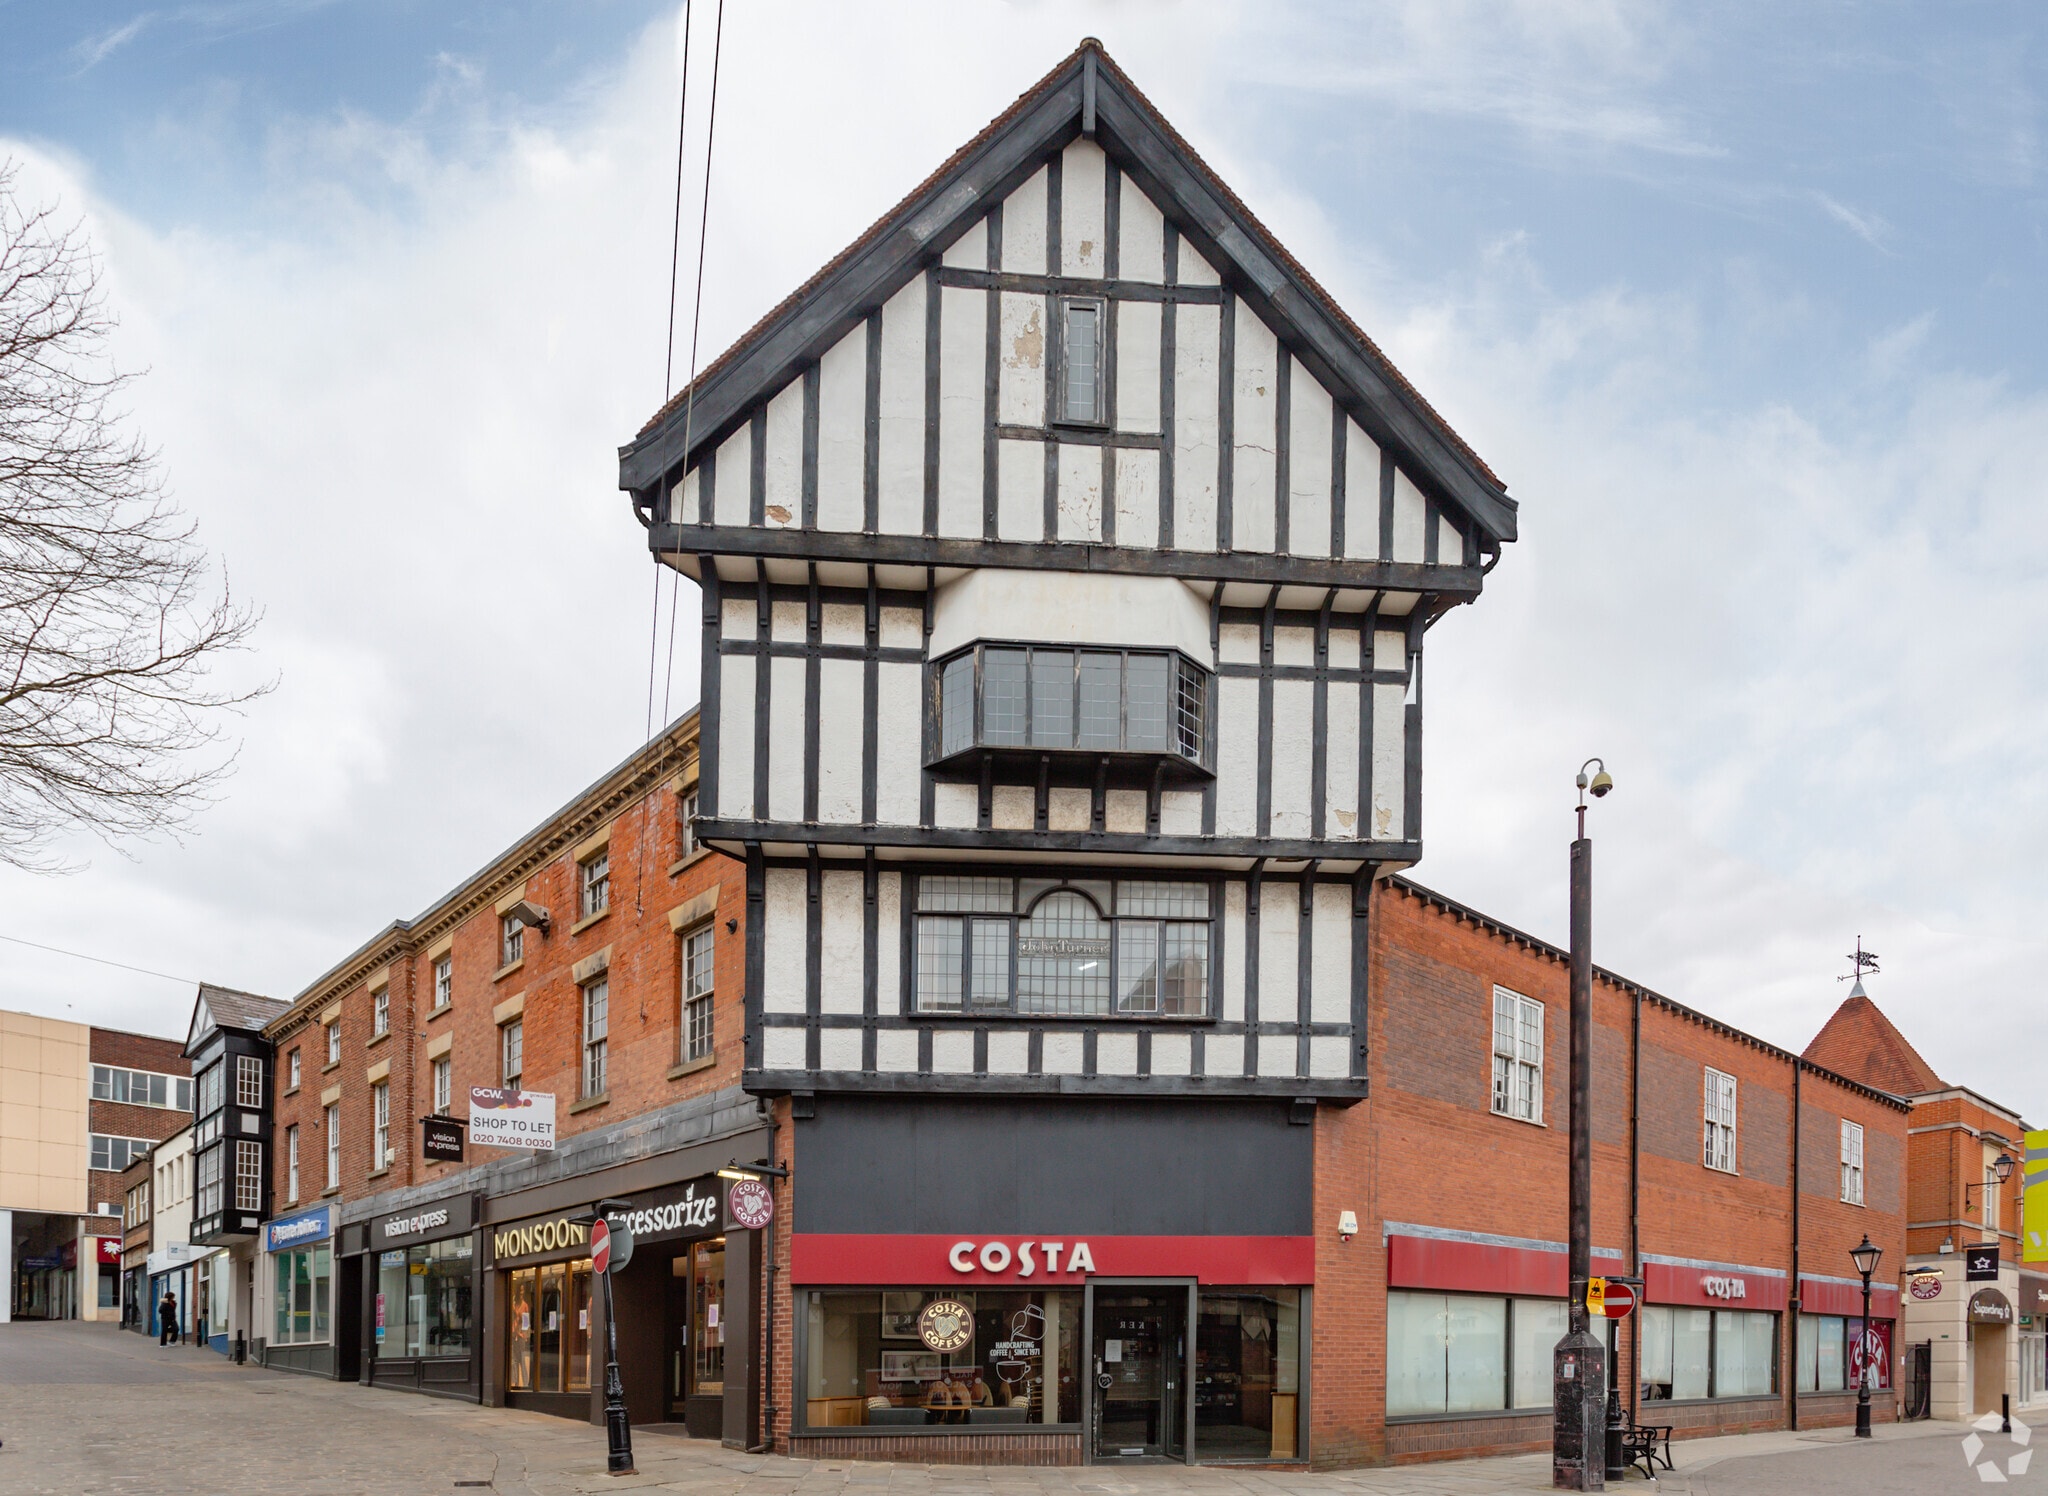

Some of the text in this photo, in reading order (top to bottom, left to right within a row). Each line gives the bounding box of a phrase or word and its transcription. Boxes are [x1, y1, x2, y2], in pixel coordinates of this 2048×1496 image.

[1021, 939, 1107, 953] John Turner
[473, 1116, 553, 1134] SHOP TO LET
[432, 1132, 456, 1143] vision
[473, 1133, 552, 1148] 020 7408 0030
[738, 1183, 766, 1198] COSTA
[384, 1209, 449, 1237] vision express
[736, 1206, 769, 1225] COFFEE
[494, 1218, 584, 1260] MONSOON
[948, 1241, 1096, 1277] COSTA
[1704, 1275, 1746, 1300] COSTA
[1915, 1276, 1936, 1285] COSTA
[928, 1303, 963, 1319] COSTA
[1973, 1300, 2004, 1319] Superdrug
[925, 1330, 968, 1349] COFFEE
[995, 1341, 1035, 1349] HANDCRAFTING
